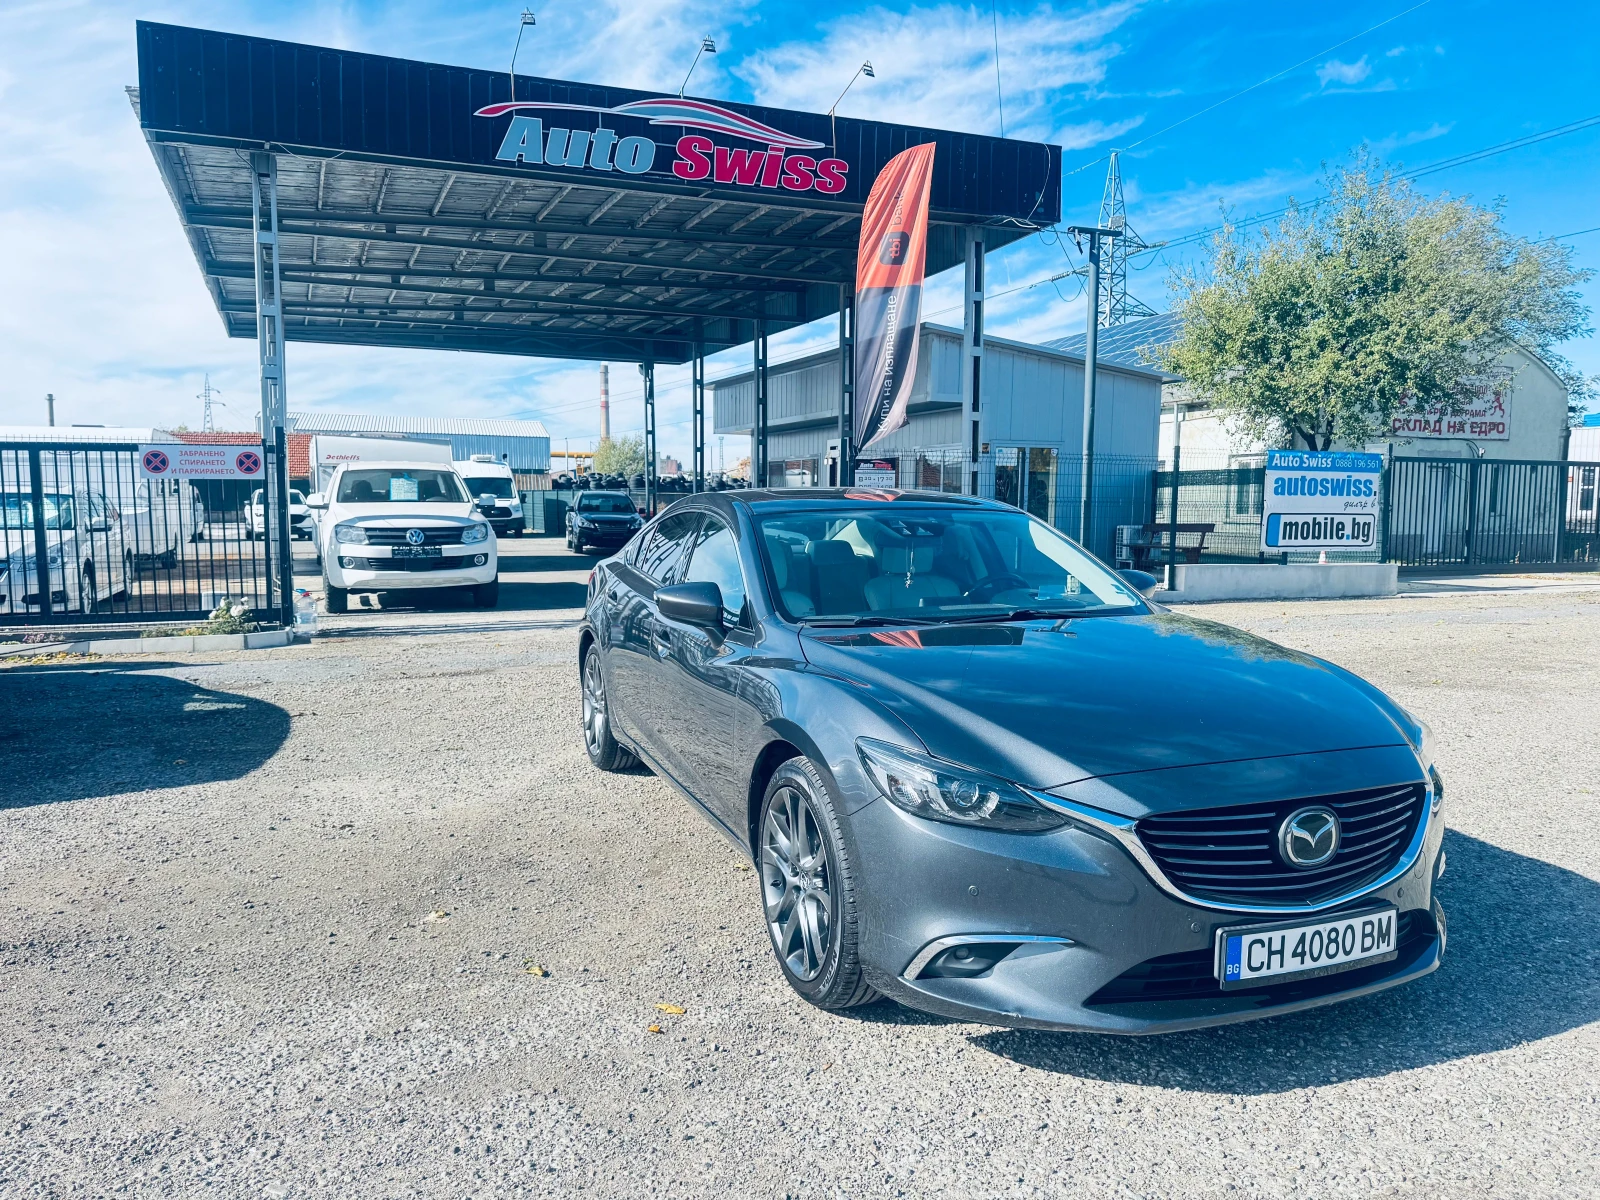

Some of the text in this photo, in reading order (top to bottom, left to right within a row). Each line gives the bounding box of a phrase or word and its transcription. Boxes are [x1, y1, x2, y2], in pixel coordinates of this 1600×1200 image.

[495, 115, 849, 194] Auto Swiss
[888, 190, 905, 259] tbi bank
[877, 295, 897, 432] Купи на изплащане
[1392, 418, 1506, 436] СКЛАД НА ЕДРО
[1272, 454, 1379, 469] Auto Swiss 0888 196 561
[1273, 475, 1377, 498] autoswiss.
[1282, 517, 1371, 543] mobile.bg
[1247, 915, 1392, 972] CH 4080 BM
[1226, 963, 1240, 975] BG
